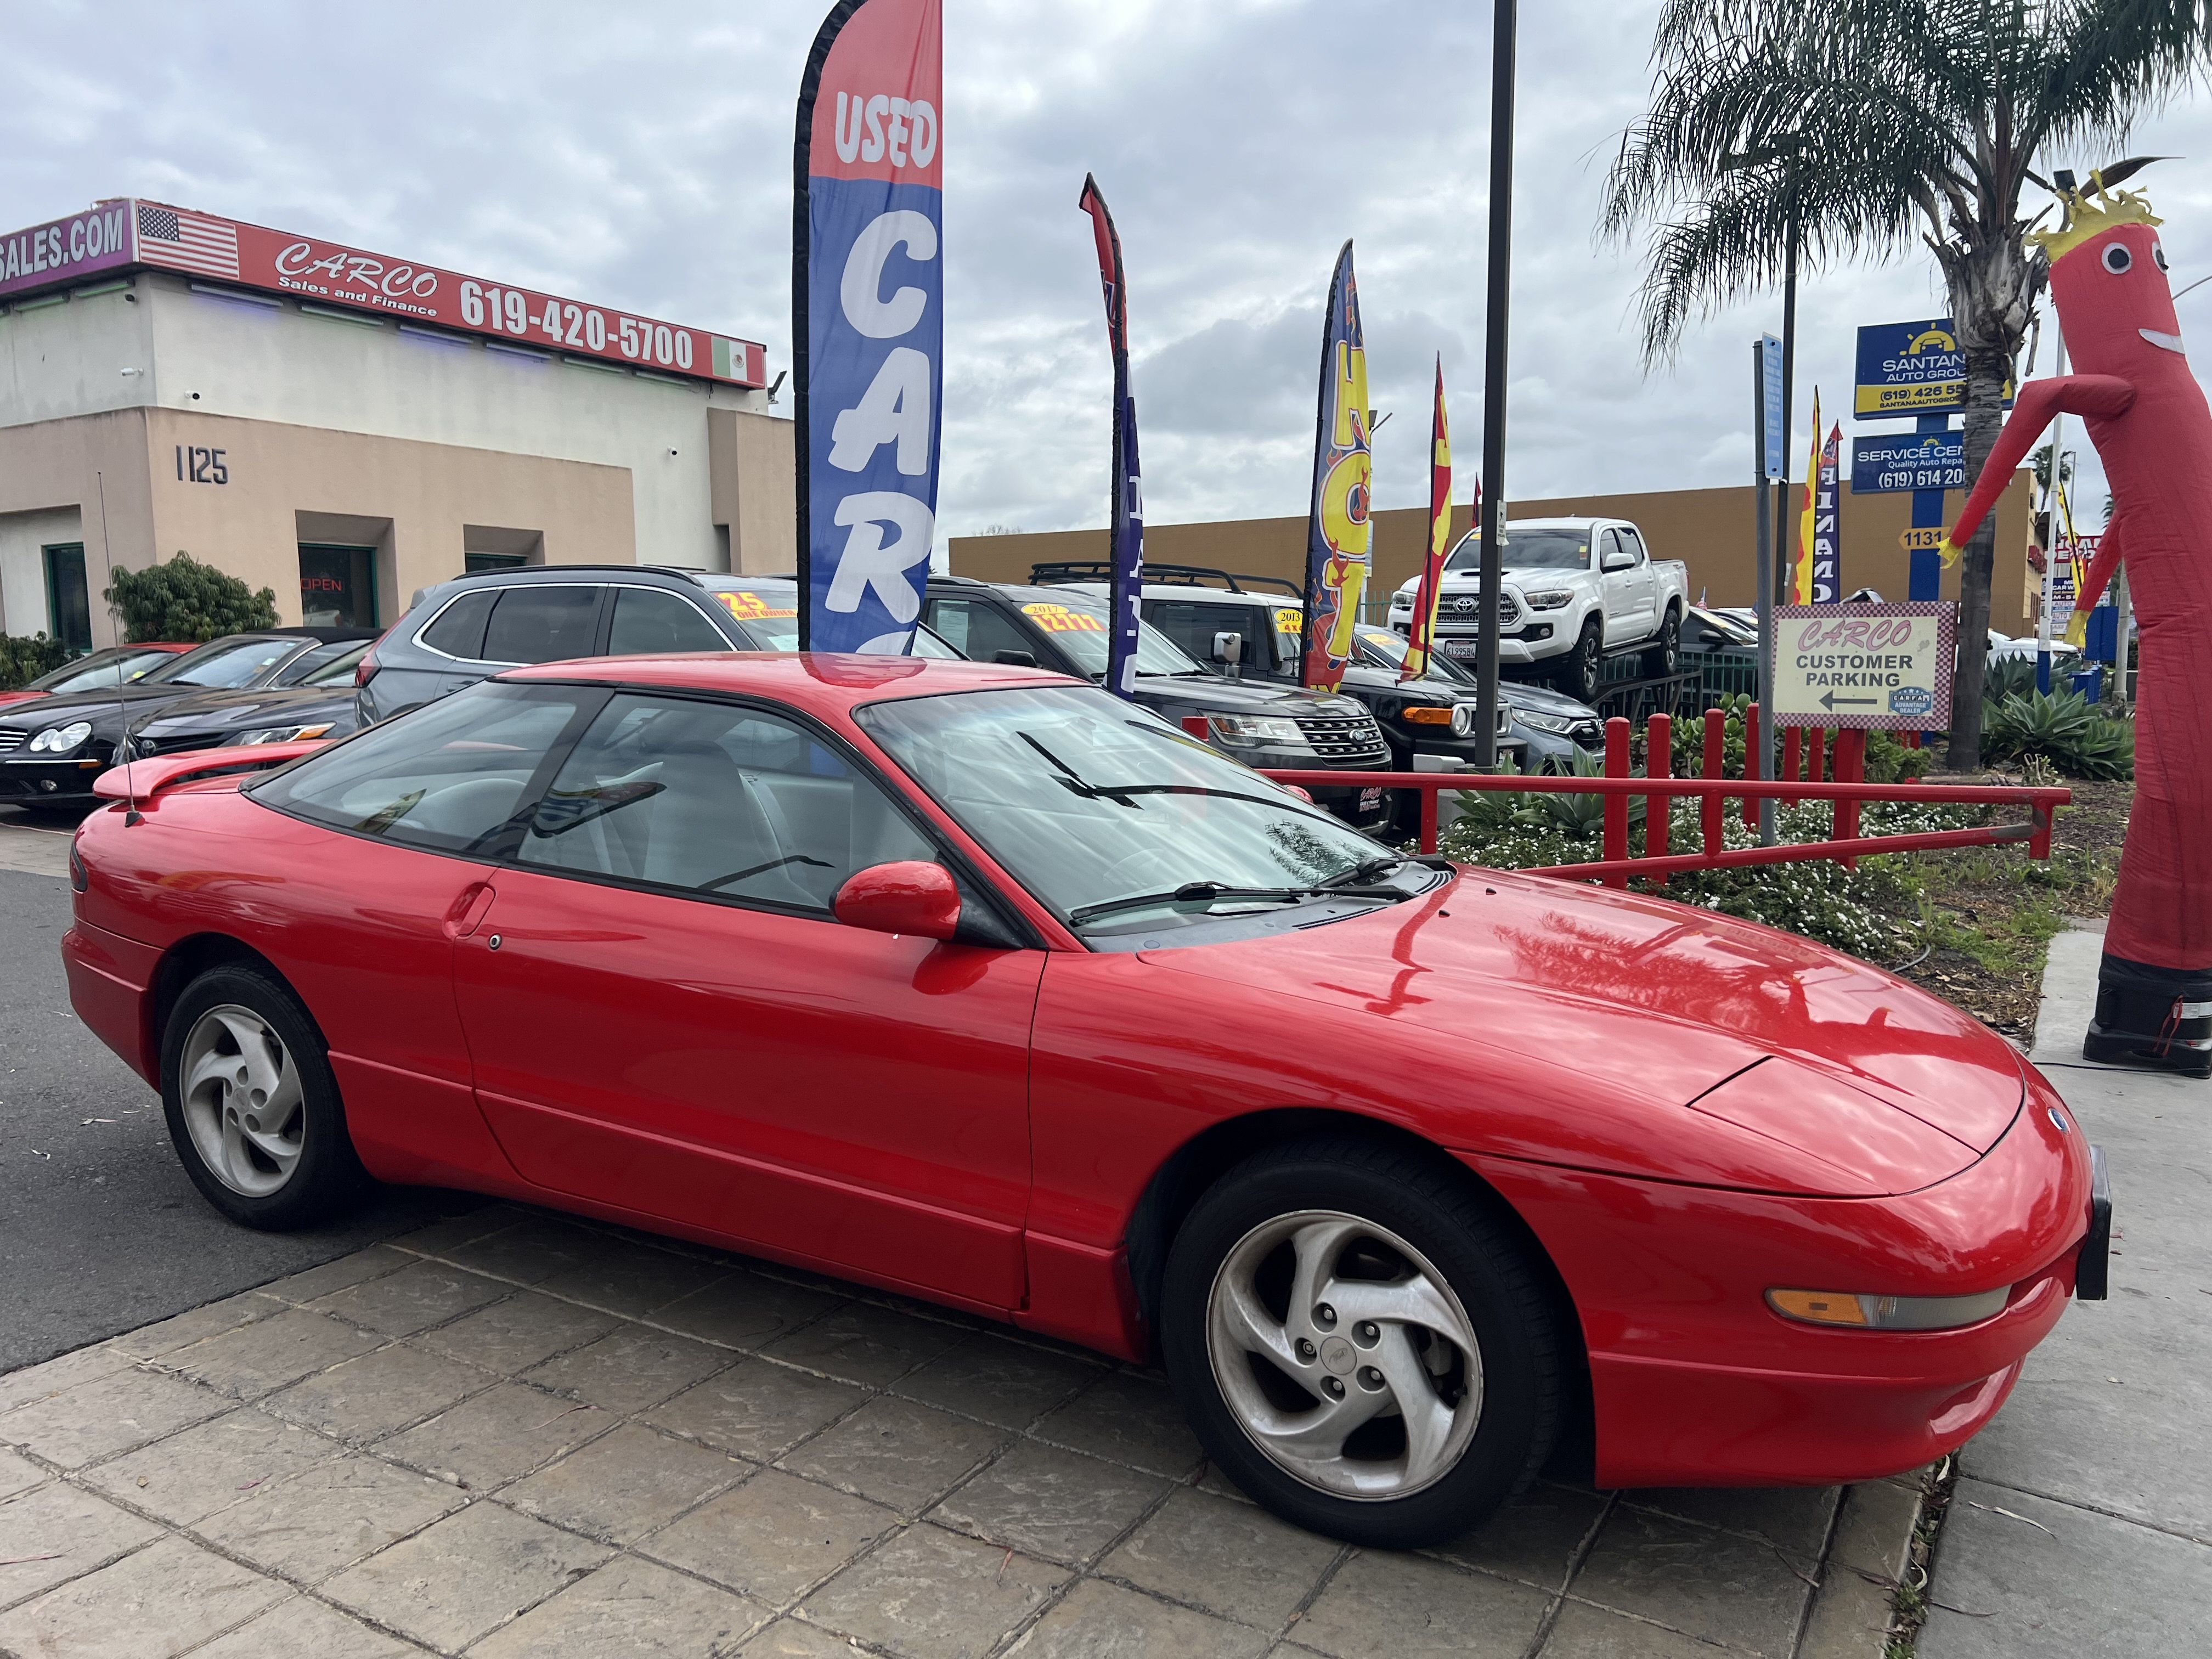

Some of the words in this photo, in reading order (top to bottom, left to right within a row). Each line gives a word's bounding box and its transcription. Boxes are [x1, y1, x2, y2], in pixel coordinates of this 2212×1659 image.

[835, 91, 938, 168] USED
[275, 242, 438, 297] CARCO
[278, 276, 329, 295] Sales
[334, 288, 366, 302] and
[372, 295, 437, 317] Finance
[460, 280, 693, 369] 619-420-5700
[1886, 370, 1924, 382] AUTO
[1880, 389, 1911, 402] (619)
[1914, 386, 1943, 397] 426
[825, 209, 938, 653] CAR
[1858, 446, 1930, 462] SERVICE
[176, 445, 228, 484] 1125
[1888, 460, 1918, 469] Quality
[1878, 470, 1913, 488] (619)
[1917, 469, 1941, 486] 614
[1944, 468, 1965, 484] 20
[1904, 531, 1942, 546] 1131
[301, 577, 342, 591] OPEN
[717, 592, 767, 611] 25
[1030, 605, 1058, 614] 2017
[737, 610, 760, 618] ONE
[1280, 612, 1301, 622] 2013
[1798, 619, 1911, 651] CARCO
[1796, 655, 1912, 669] CUSTOMER
[1806, 673, 1899, 686] PARKING
